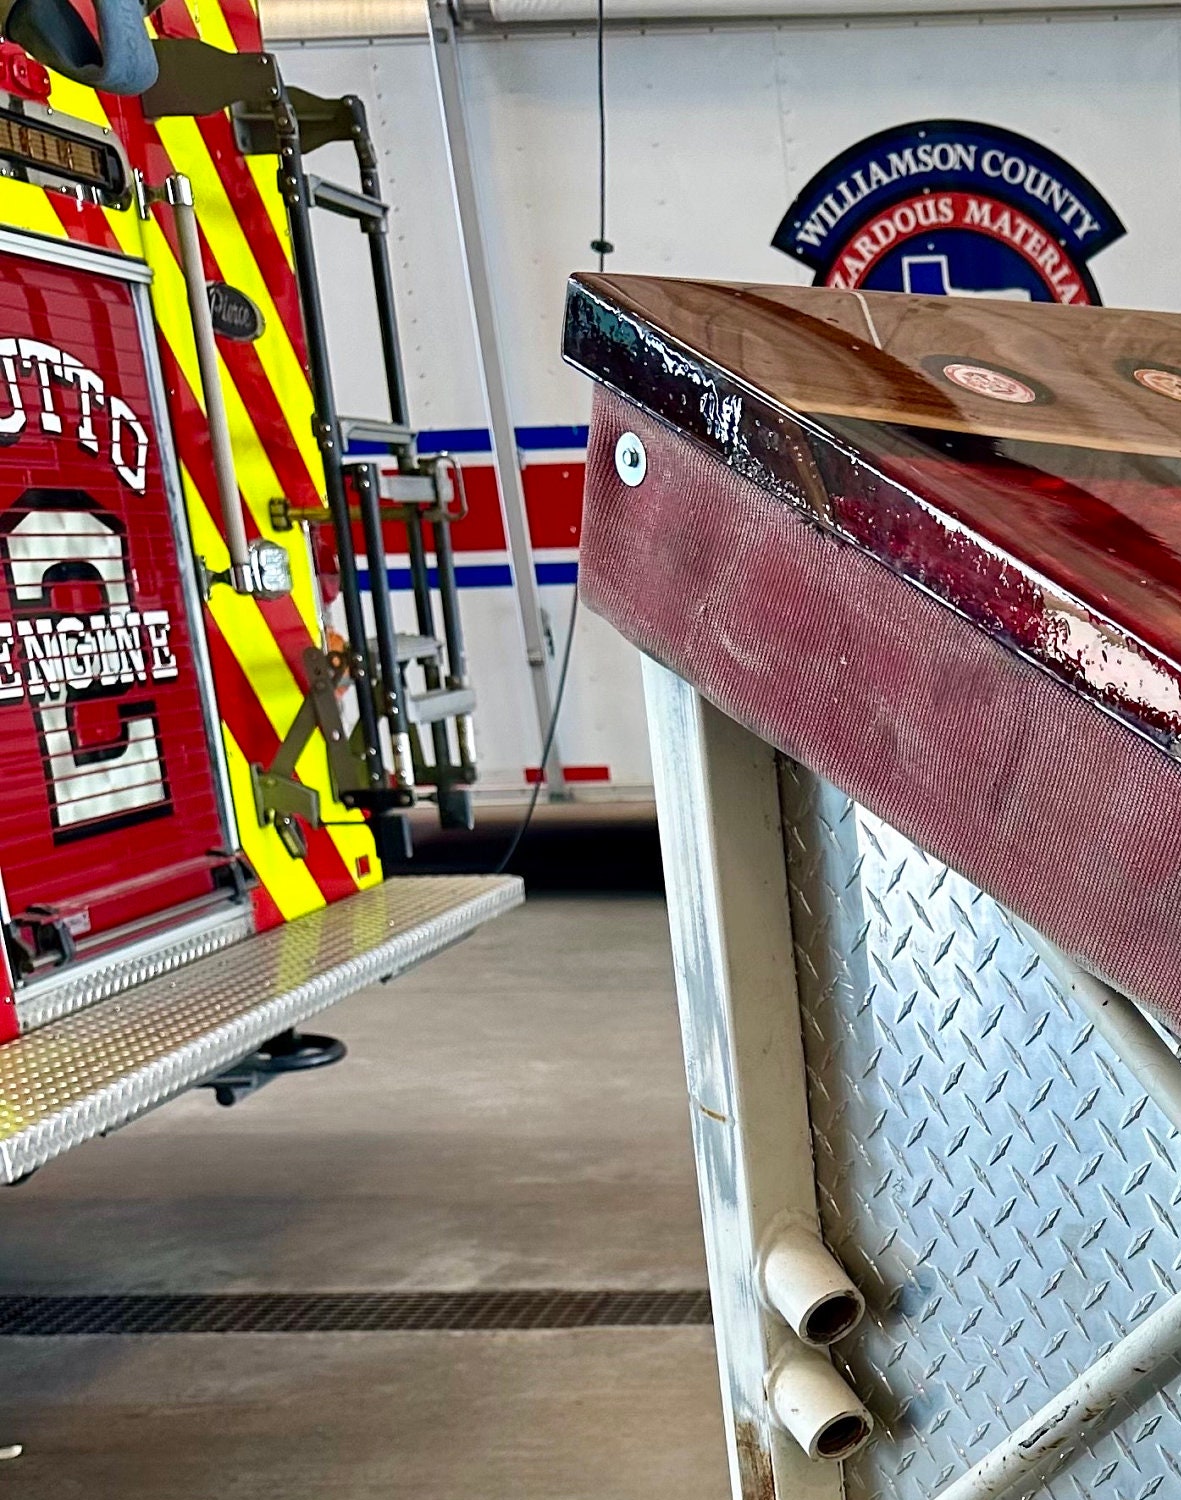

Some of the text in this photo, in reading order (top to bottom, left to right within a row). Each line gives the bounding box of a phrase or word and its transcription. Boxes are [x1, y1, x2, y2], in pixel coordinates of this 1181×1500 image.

[796, 143, 1101, 248] WILLIAMSON COUNTY
[830, 198, 1086, 306] ZARDOUS MATERIA
[0, 338, 149, 494] UTTO
[0, 610, 179, 699] ENGINE
